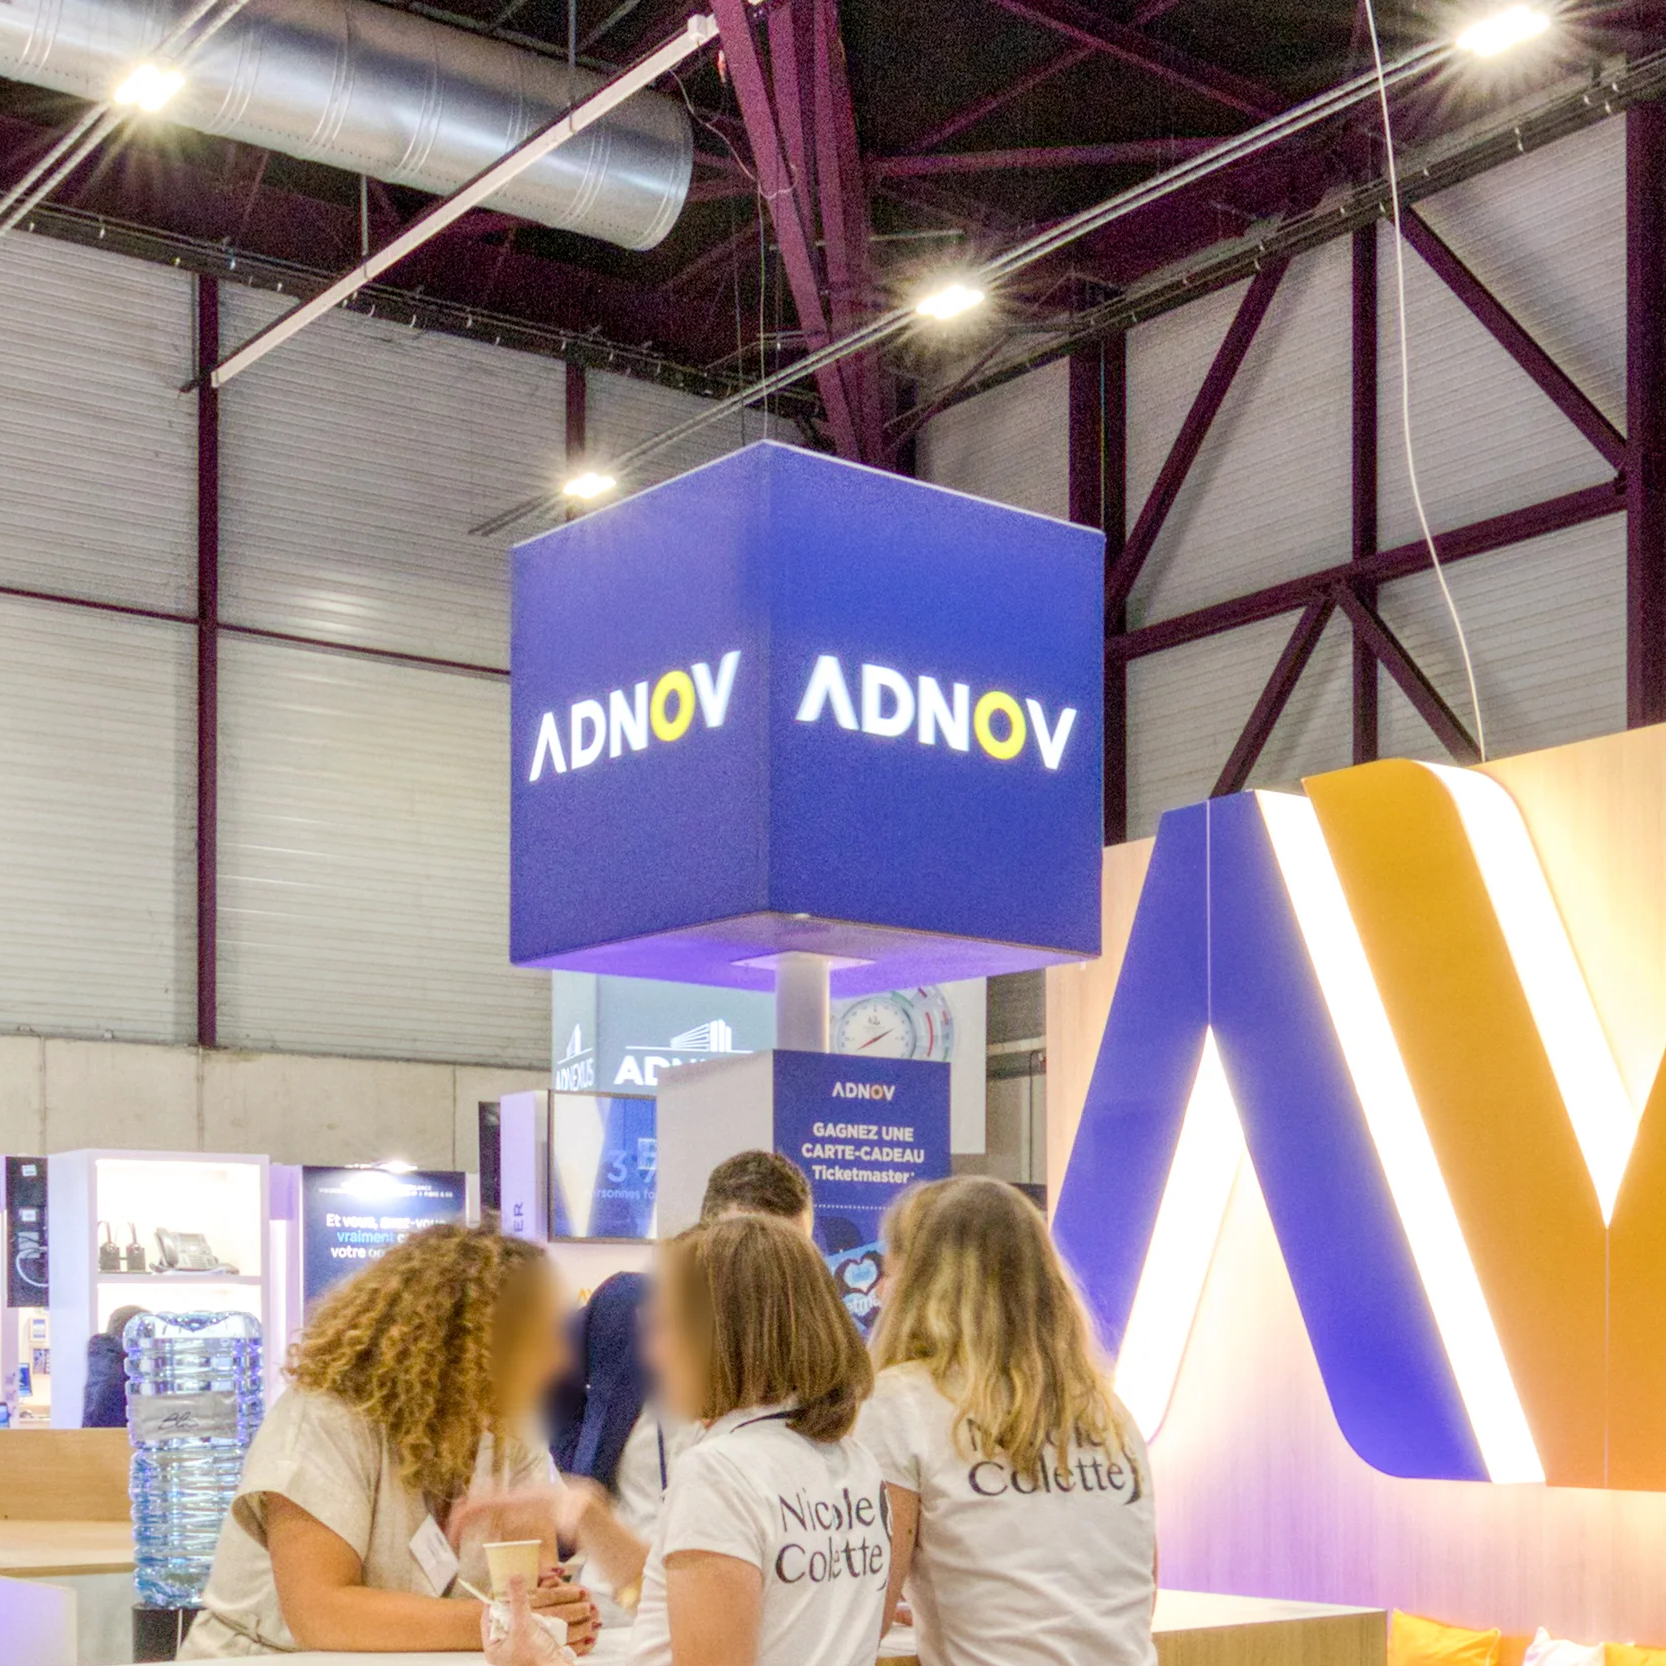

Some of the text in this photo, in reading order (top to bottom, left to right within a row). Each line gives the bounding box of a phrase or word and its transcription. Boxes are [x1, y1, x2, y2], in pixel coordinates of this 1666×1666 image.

[529, 650, 741, 782] ADNOV
[796, 655, 1076, 770] ADNOV
[555, 1057, 594, 1091] ADNEXUS
[831, 1081, 896, 1101] ADNOV
[812, 1122, 914, 1142] GAGNEZ UNE
[801, 1143, 925, 1163] CARTE-CADEAU
[326, 1212, 341, 1228] Et
[379, 1216, 446, 1230] avez-vo
[336, 1230, 395, 1244] vraiment
[330, 1245, 367, 1259] votre
[967, 1452, 1128, 1497] Colette
[777, 1486, 876, 1533] Nicole
[775, 1535, 884, 1585] Colette
